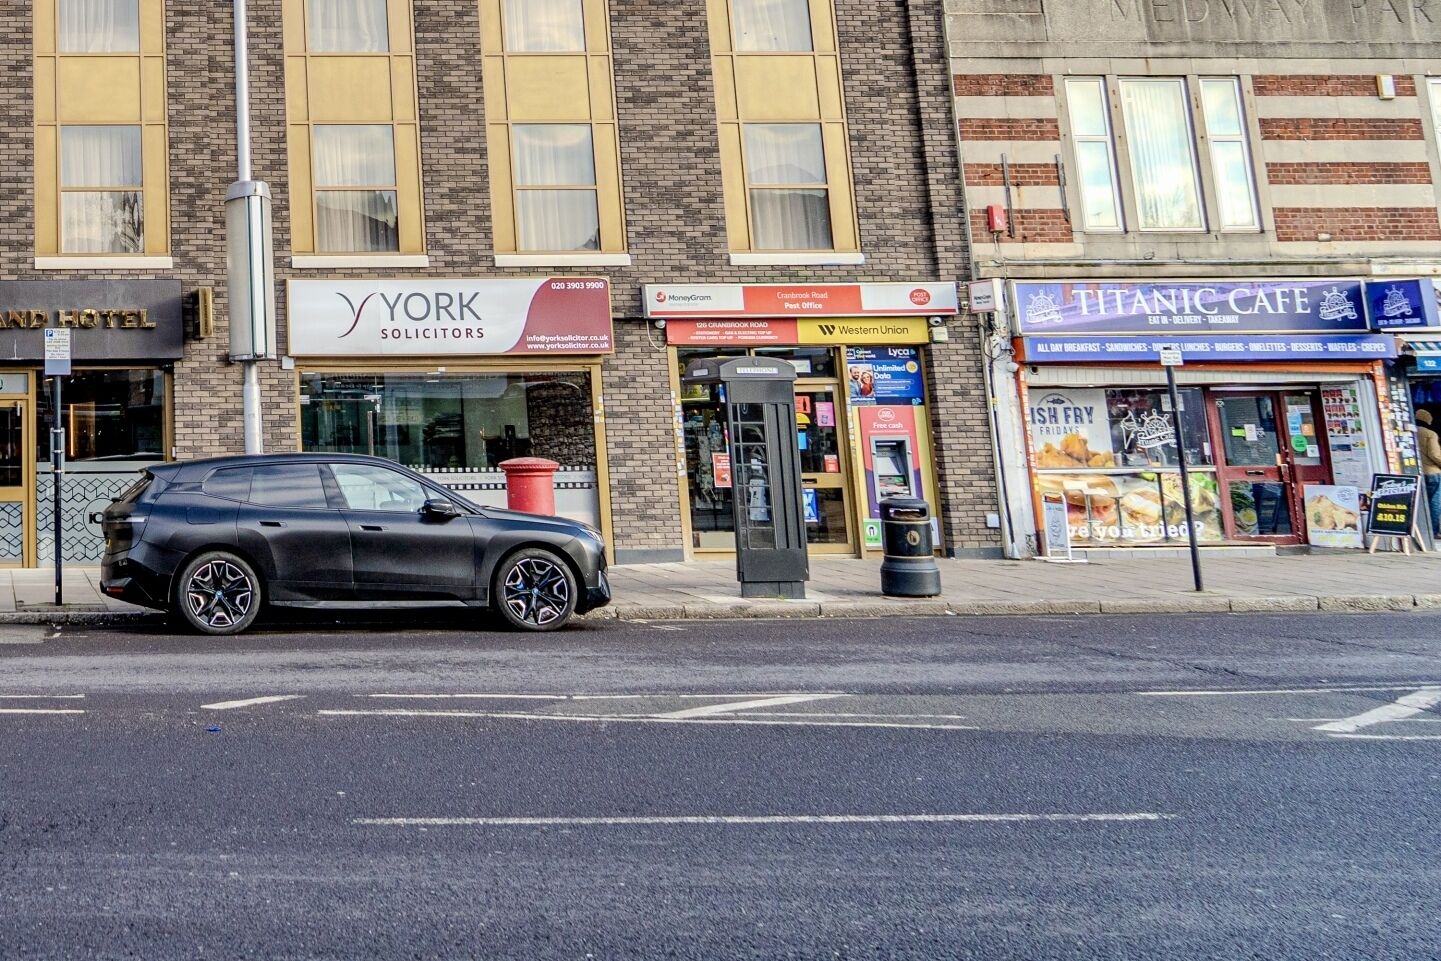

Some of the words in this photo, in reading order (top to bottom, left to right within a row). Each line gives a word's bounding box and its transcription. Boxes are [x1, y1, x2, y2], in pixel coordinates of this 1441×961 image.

[551, 282, 565, 290] 020
[585, 281, 604, 289] 9900
[668, 294, 712, 303] MoneyGram
[776, 291, 810, 299] Cranbrook
[811, 291, 828, 299] Road
[380, 291, 483, 322] YORK
[801, 301, 823, 309] Office
[1072, 288, 1218, 315] TITANIC
[1228, 288, 1311, 315] CAFE
[58, 308, 157, 329] HOTEL
[1148, 316, 1160, 325] EAT
[1160, 316, 1169, 324] IN
[1172, 315, 1202, 324] DELIVERY
[1206, 315, 1240, 324] TAKEAWAY
[381, 327, 485, 340] SOLICITORS
[839, 325, 879, 335] Western
[880, 324, 909, 334] Union
[526, 334, 609, 343] info@yorksolicitor.co.uk
[527, 342, 609, 351] www.yorksolicitor.co.uk
[1037, 343, 1050, 353] ALL
[1050, 343, 1063, 352] DAY
[1064, 342, 1100, 352] BREAKFAST
[1106, 342, 1148, 352] SANDWICHES
[1180, 342, 1211, 352] LUNCHES
[1215, 342, 1245, 352] BURGERS
[1249, 342, 1286, 352] OMELETTES
[1291, 342, 1323, 352] DESSERTS
[1328, 342, 1357, 352] WAFFLES
[1361, 342, 1386, 352] CREPES
[888, 347, 910, 357] Lyca
[873, 364, 906, 372] Unlimited
[1030, 406, 1059, 425] ISH
[1063, 406, 1094, 425] FRY
[1040, 426, 1080, 436] FRIDAYS
[1068, 526, 1089, 538] ve
[1092, 526, 1135, 542] you
[1136, 521, 1205, 538] tried?
